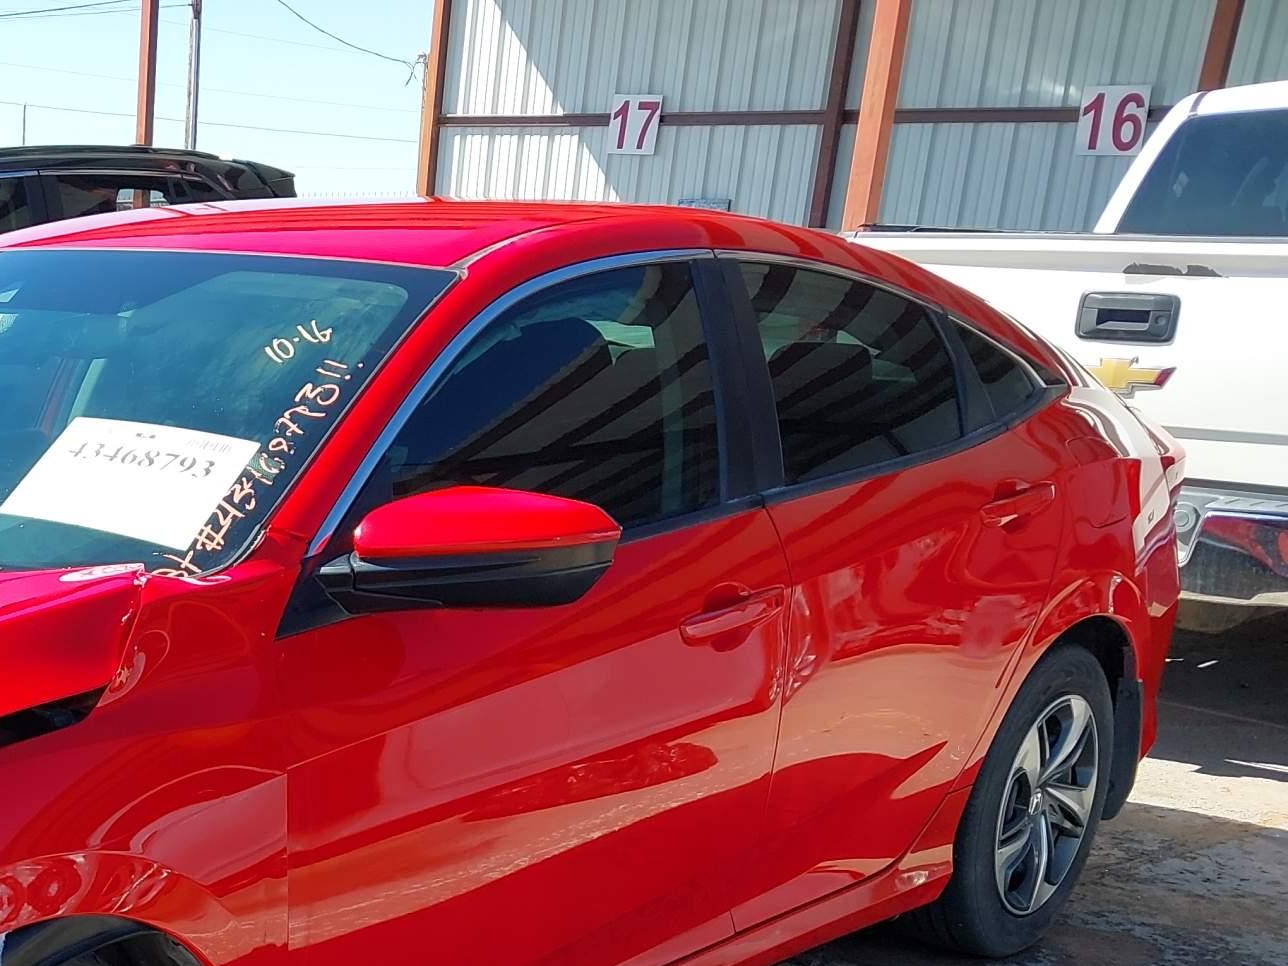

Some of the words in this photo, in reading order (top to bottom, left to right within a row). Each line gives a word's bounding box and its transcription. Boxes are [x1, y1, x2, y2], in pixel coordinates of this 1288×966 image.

[613, 100, 660, 149] 17
[1082, 93, 1145, 151] 16
[68, 441, 216, 478] 43468793
